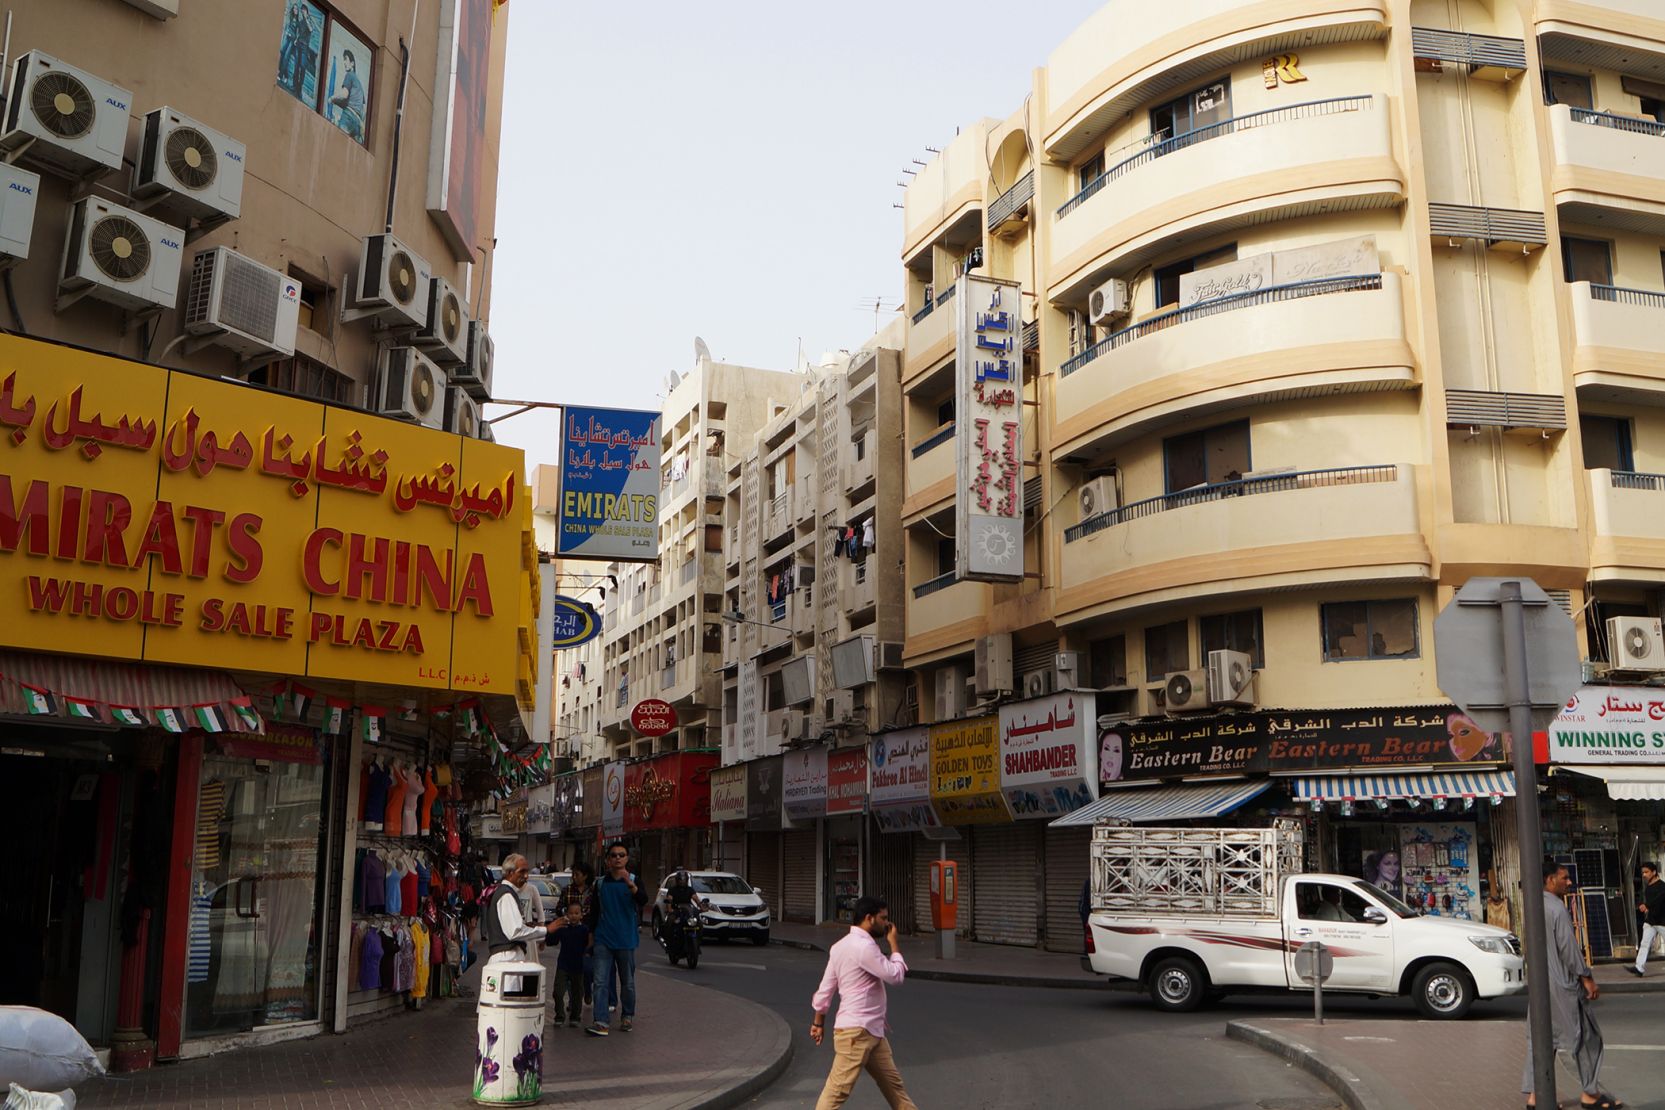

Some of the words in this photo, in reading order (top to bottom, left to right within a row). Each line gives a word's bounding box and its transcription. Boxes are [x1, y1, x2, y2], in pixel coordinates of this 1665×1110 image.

[106, 97, 126, 111] AUX
[225, 151, 242, 163] AUX
[9, 182, 33, 196] AUX
[160, 238, 180, 250] AUX
[43, 383, 157, 461] سيل
[163, 405, 254, 479] هول
[259, 424, 388, 497] تشاينا
[564, 490, 657, 522] EMIRATS
[564, 523, 587, 534] CHINA
[303, 527, 495, 617] CHINA
[26, 576, 185, 626] WHOLE
[200, 598, 294, 639] SALE
[307, 611, 425, 654] PLAZA
[1598, 695, 1643, 718] ستار
[1217, 722, 1257, 736] شركة
[1341, 716, 1384, 730] الدب
[1394, 715, 1444, 728] شركة
[1180, 727, 1211, 739] الدب
[1556, 731, 1646, 748] WINNING
[1130, 751, 1201, 770] Eastern
[1209, 745, 1258, 763] Bear
[1268, 740, 1372, 759] Eastern
[1382, 738, 1447, 755] Bear
[936, 758, 968, 775] GOLDEN
[972, 755, 993, 770] TOYS
[1005, 743, 1077, 776] SHAHBANDER
